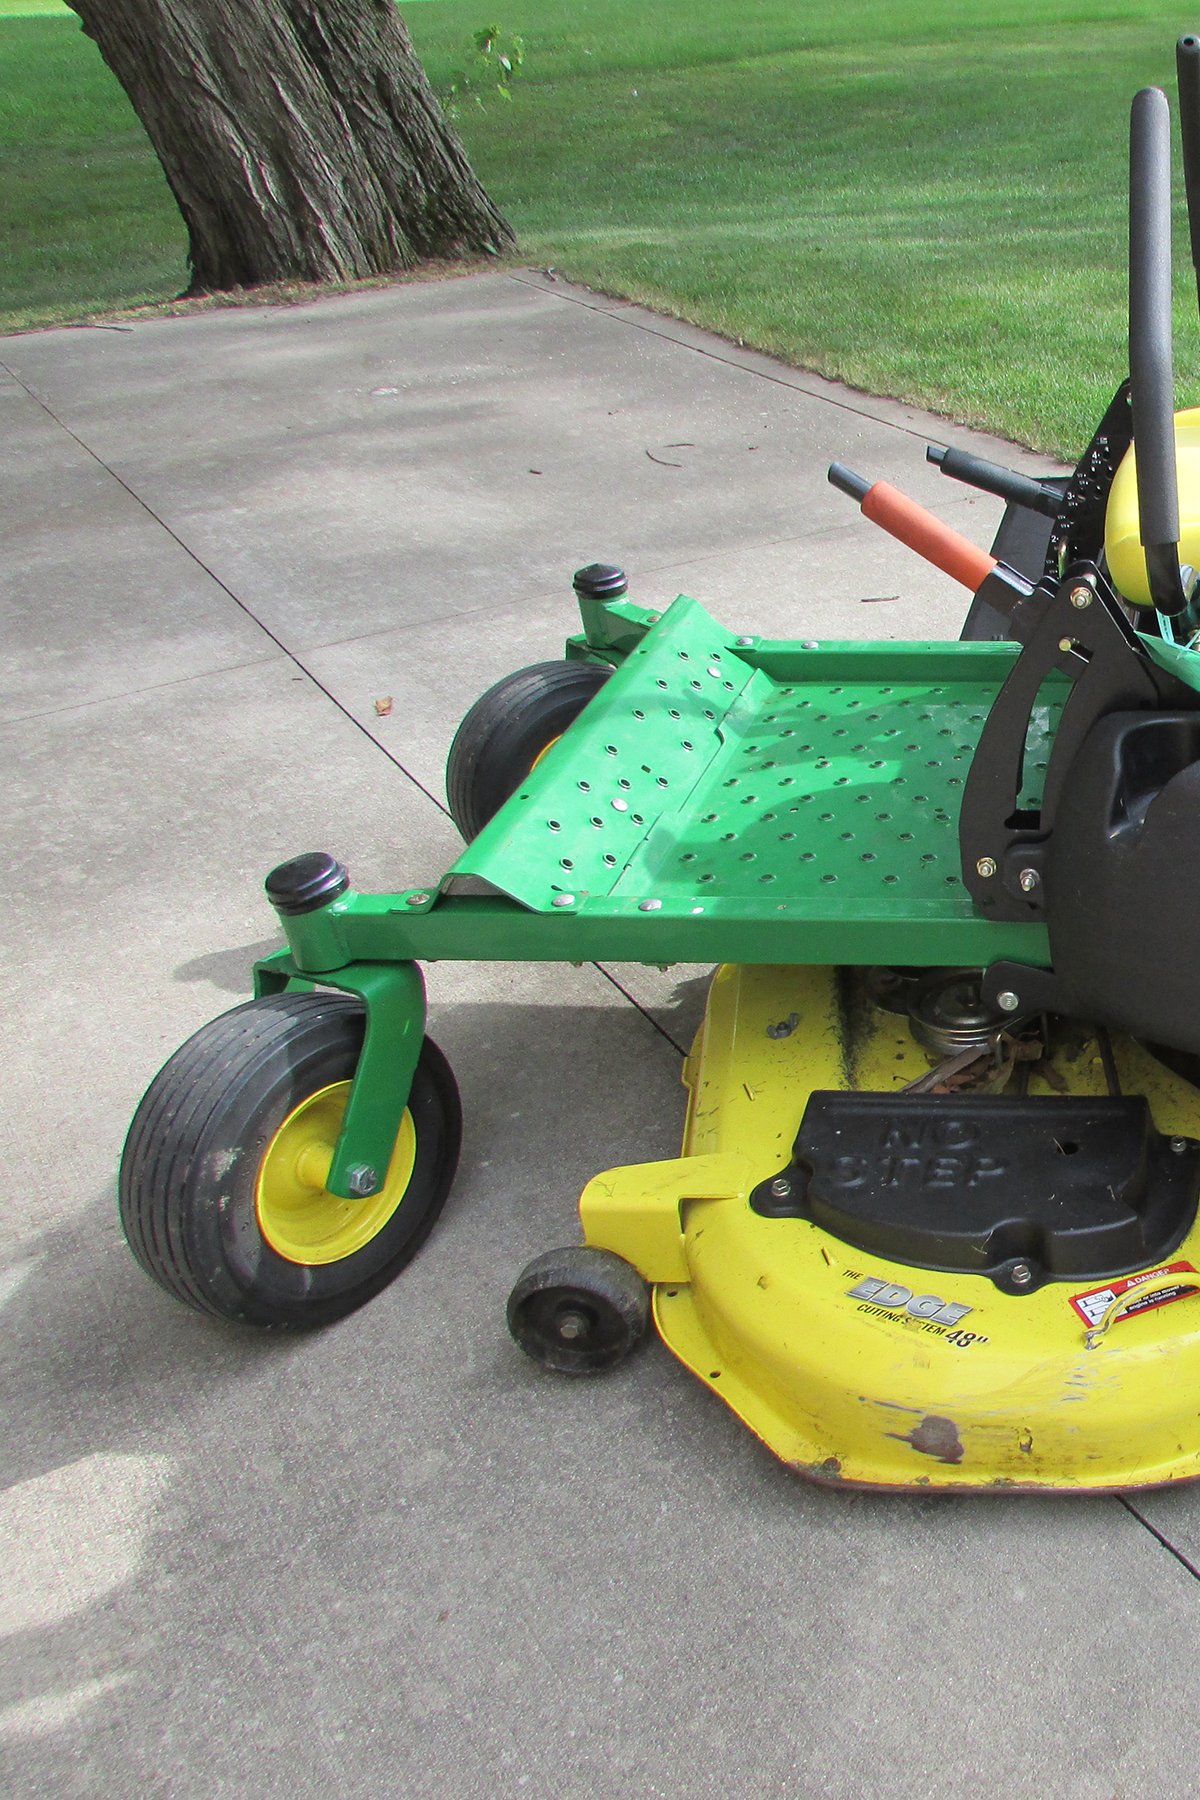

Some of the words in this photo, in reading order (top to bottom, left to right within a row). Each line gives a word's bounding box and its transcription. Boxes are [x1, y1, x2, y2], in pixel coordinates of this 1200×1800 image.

[880, 1118, 979, 1150] NO
[834, 1155, 1009, 1188] STEP
[842, 1269, 864, 1281] THE
[1134, 1268, 1170, 1284] DANGER
[845, 1276, 975, 1327] EDGE
[857, 1303, 901, 1323] CUTTING
[945, 1329, 989, 1348] 48"
